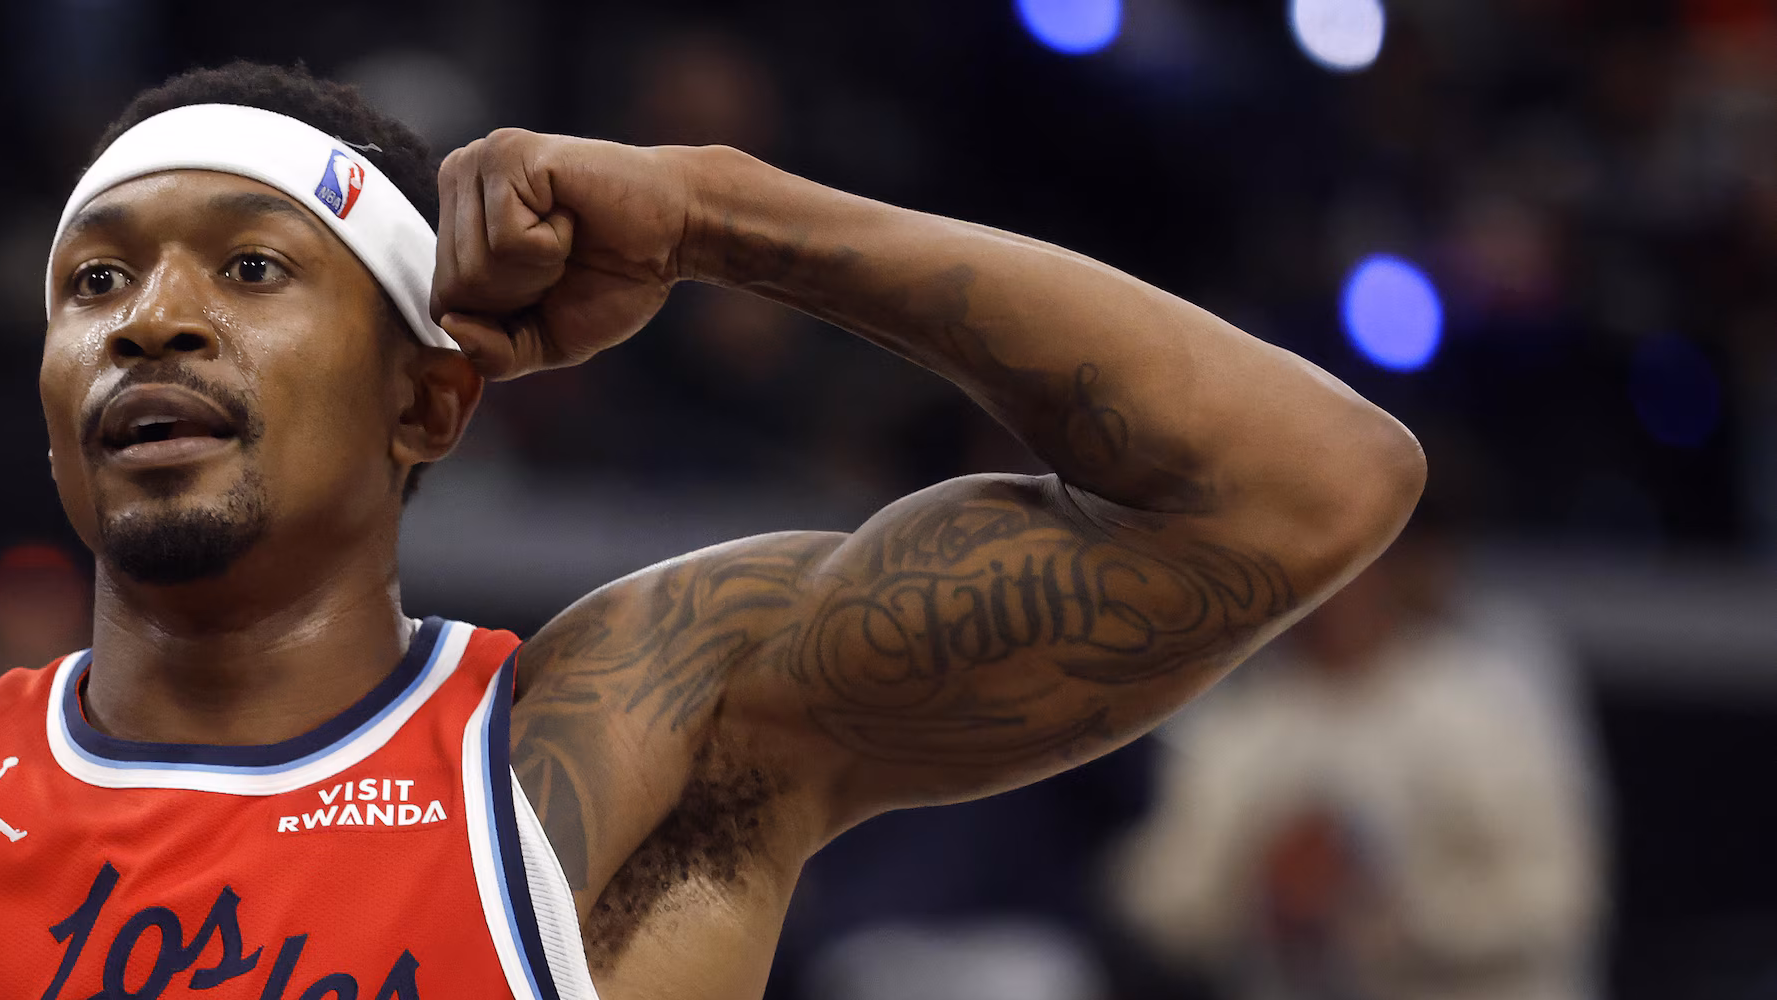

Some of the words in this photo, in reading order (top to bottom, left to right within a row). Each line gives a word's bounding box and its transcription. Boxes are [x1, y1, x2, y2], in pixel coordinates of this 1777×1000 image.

[317, 186, 342, 209] NBA
[318, 778, 415, 805] VISIT
[277, 800, 448, 832] RWANDA
